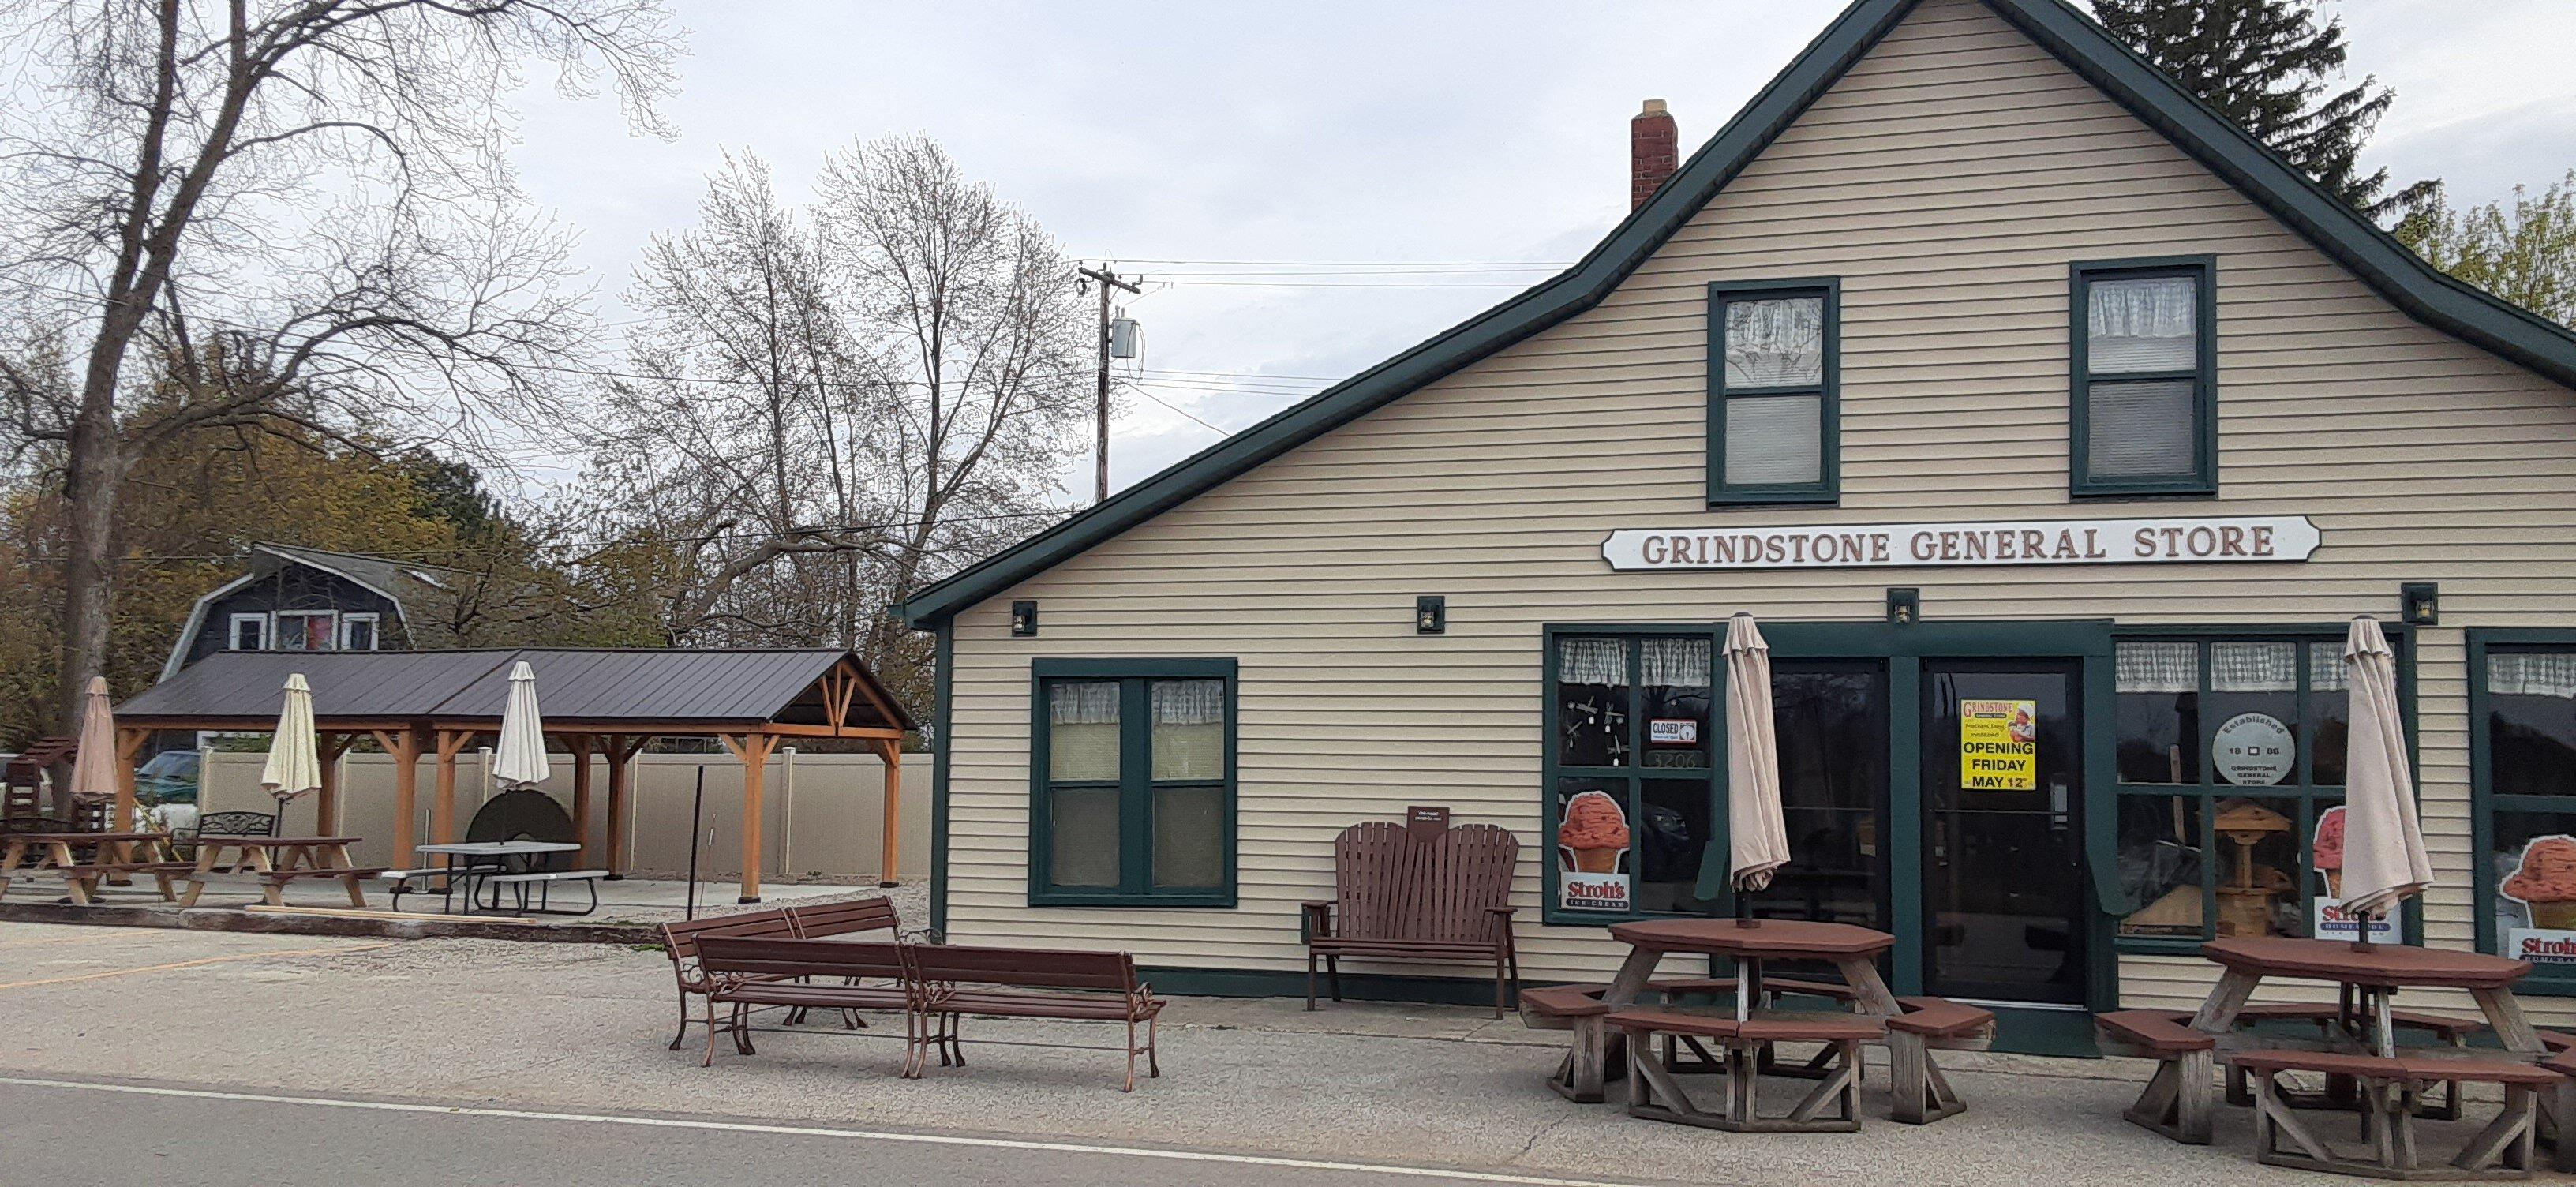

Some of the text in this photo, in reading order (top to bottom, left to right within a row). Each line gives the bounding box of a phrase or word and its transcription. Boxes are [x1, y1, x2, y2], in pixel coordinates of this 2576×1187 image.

[1642, 526, 2275, 564] GRINDSTONE GENERAL STORE
[1963, 702, 2013, 717] GRINDSTONE
[1653, 723, 1679, 734] CLOSED
[2222, 716, 2285, 734] Established
[1964, 742, 2033, 755] OPENING
[1654, 753, 1695, 768] 3206
[1972, 759, 2026, 771] FRIDAY
[1973, 776, 2004, 788] MAY
[1567, 881, 1626, 899] Stroh's
